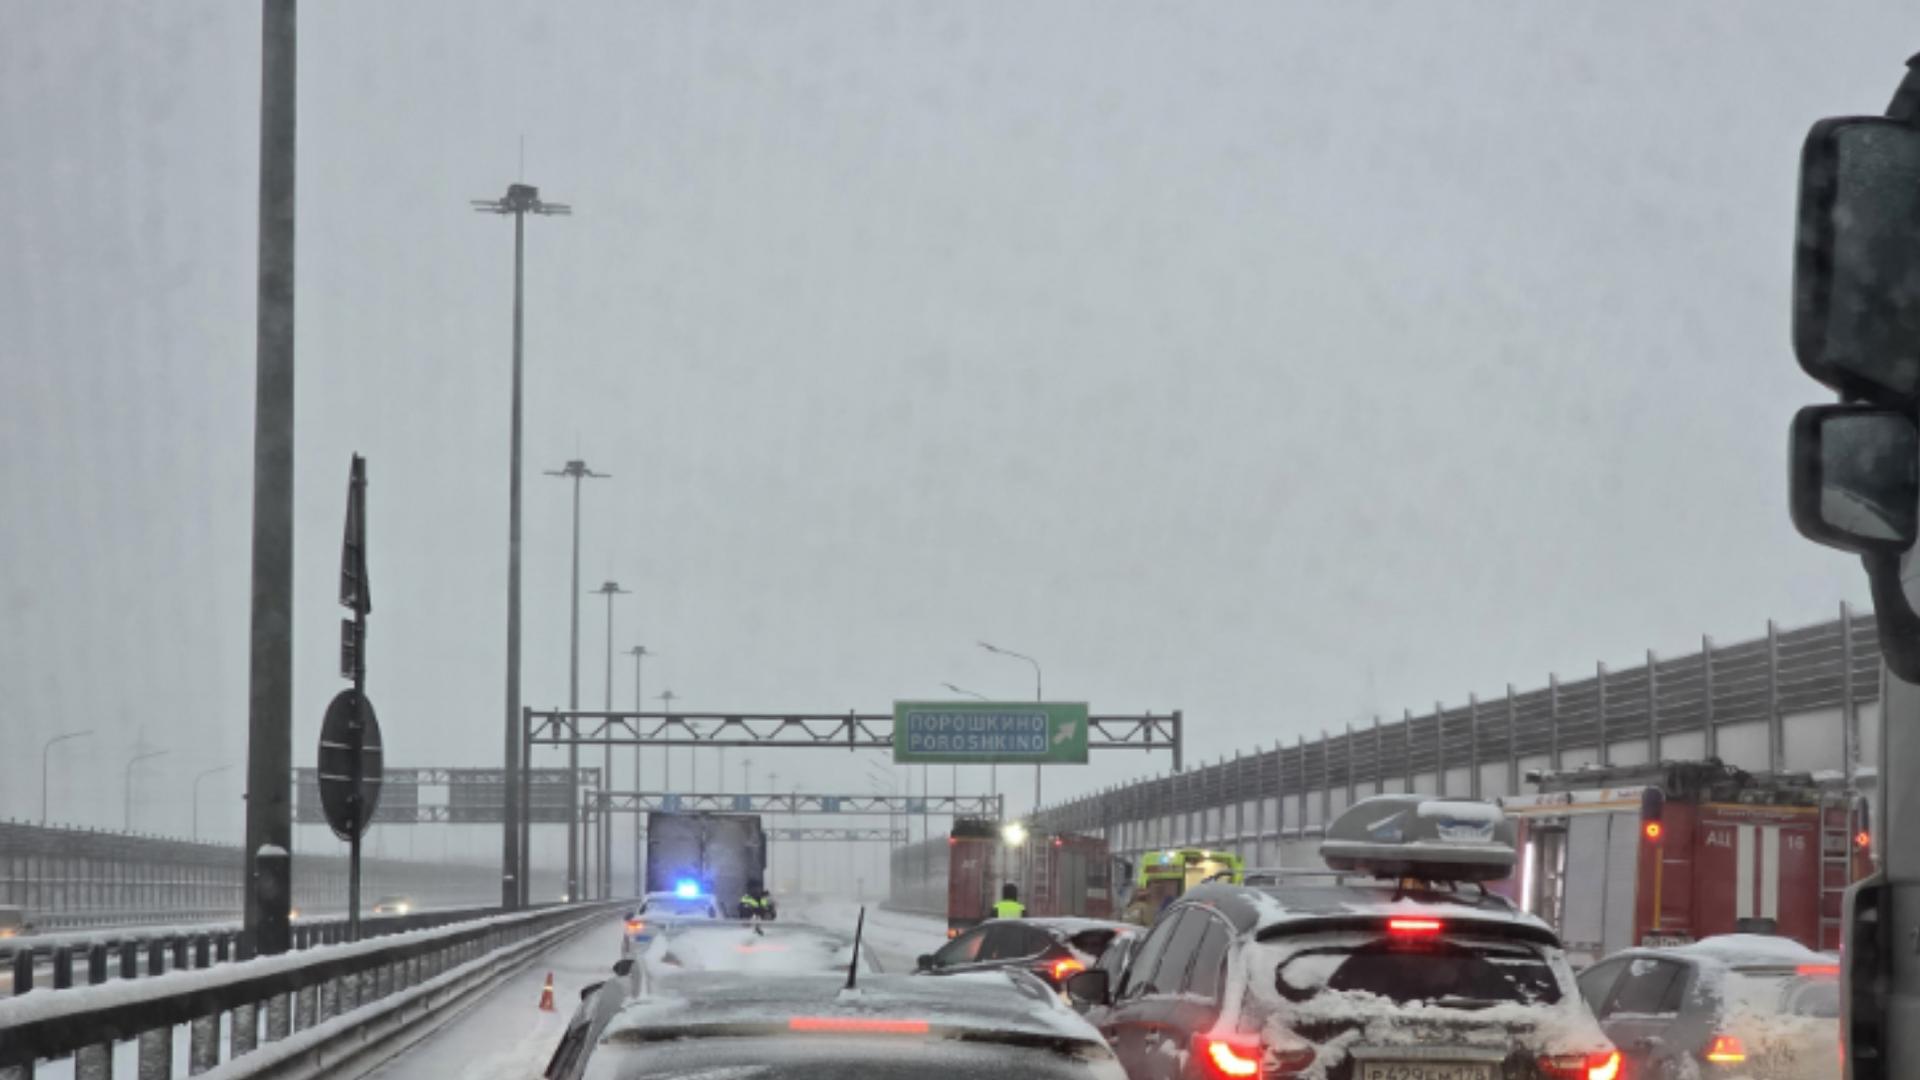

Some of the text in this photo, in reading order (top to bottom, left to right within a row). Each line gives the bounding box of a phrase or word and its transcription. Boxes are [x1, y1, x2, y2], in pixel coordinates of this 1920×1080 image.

[911, 714, 1043, 731] ПОРОШКИНО
[911, 734, 1043, 749] POROSHKINO
[1706, 829, 1732, 847] АЦ
